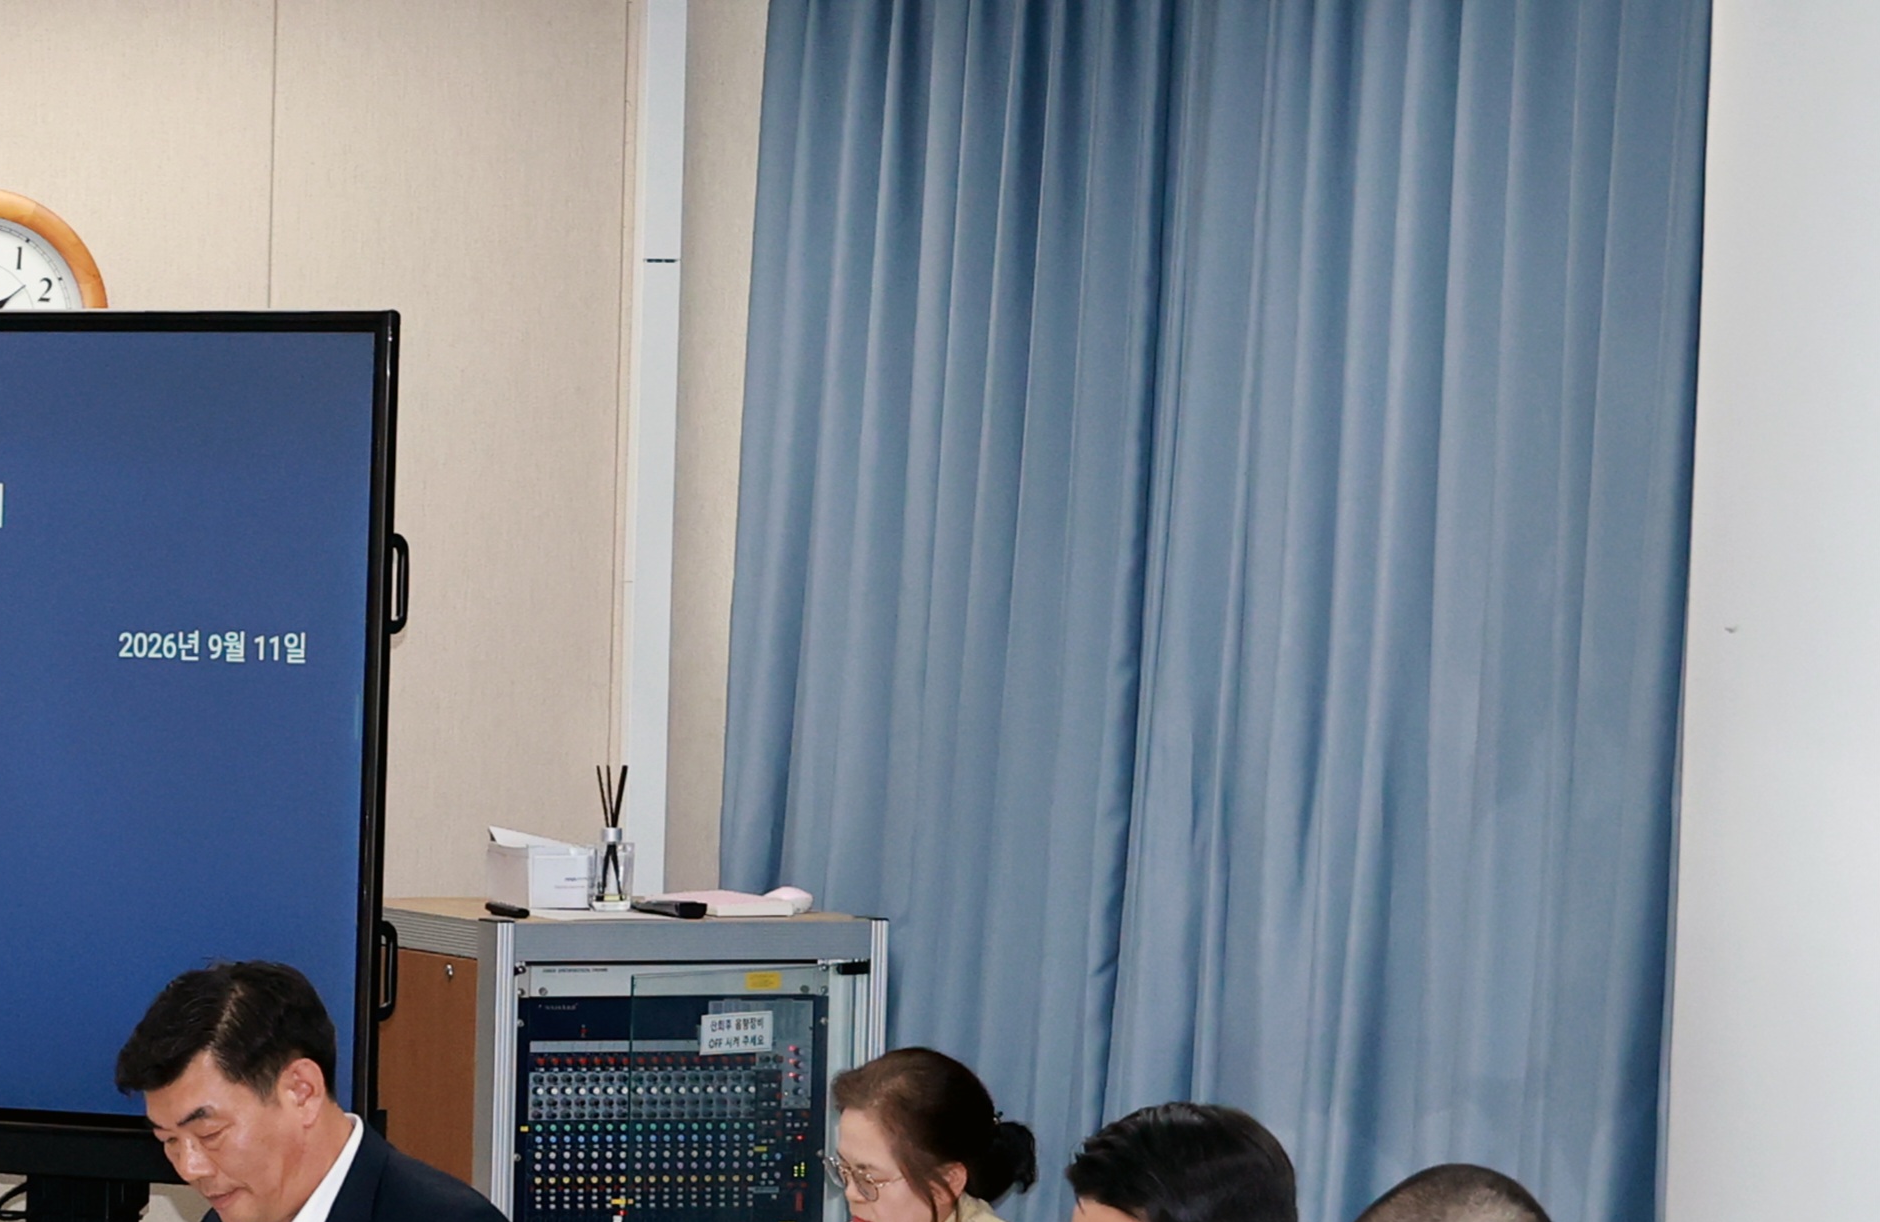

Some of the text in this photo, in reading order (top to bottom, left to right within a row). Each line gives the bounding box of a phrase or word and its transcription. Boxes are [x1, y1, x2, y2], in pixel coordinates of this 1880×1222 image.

[16, 245, 24, 271] 1
[37, 277, 53, 303] 2
[118, 629, 306, 664] 2026년 9월 11일
